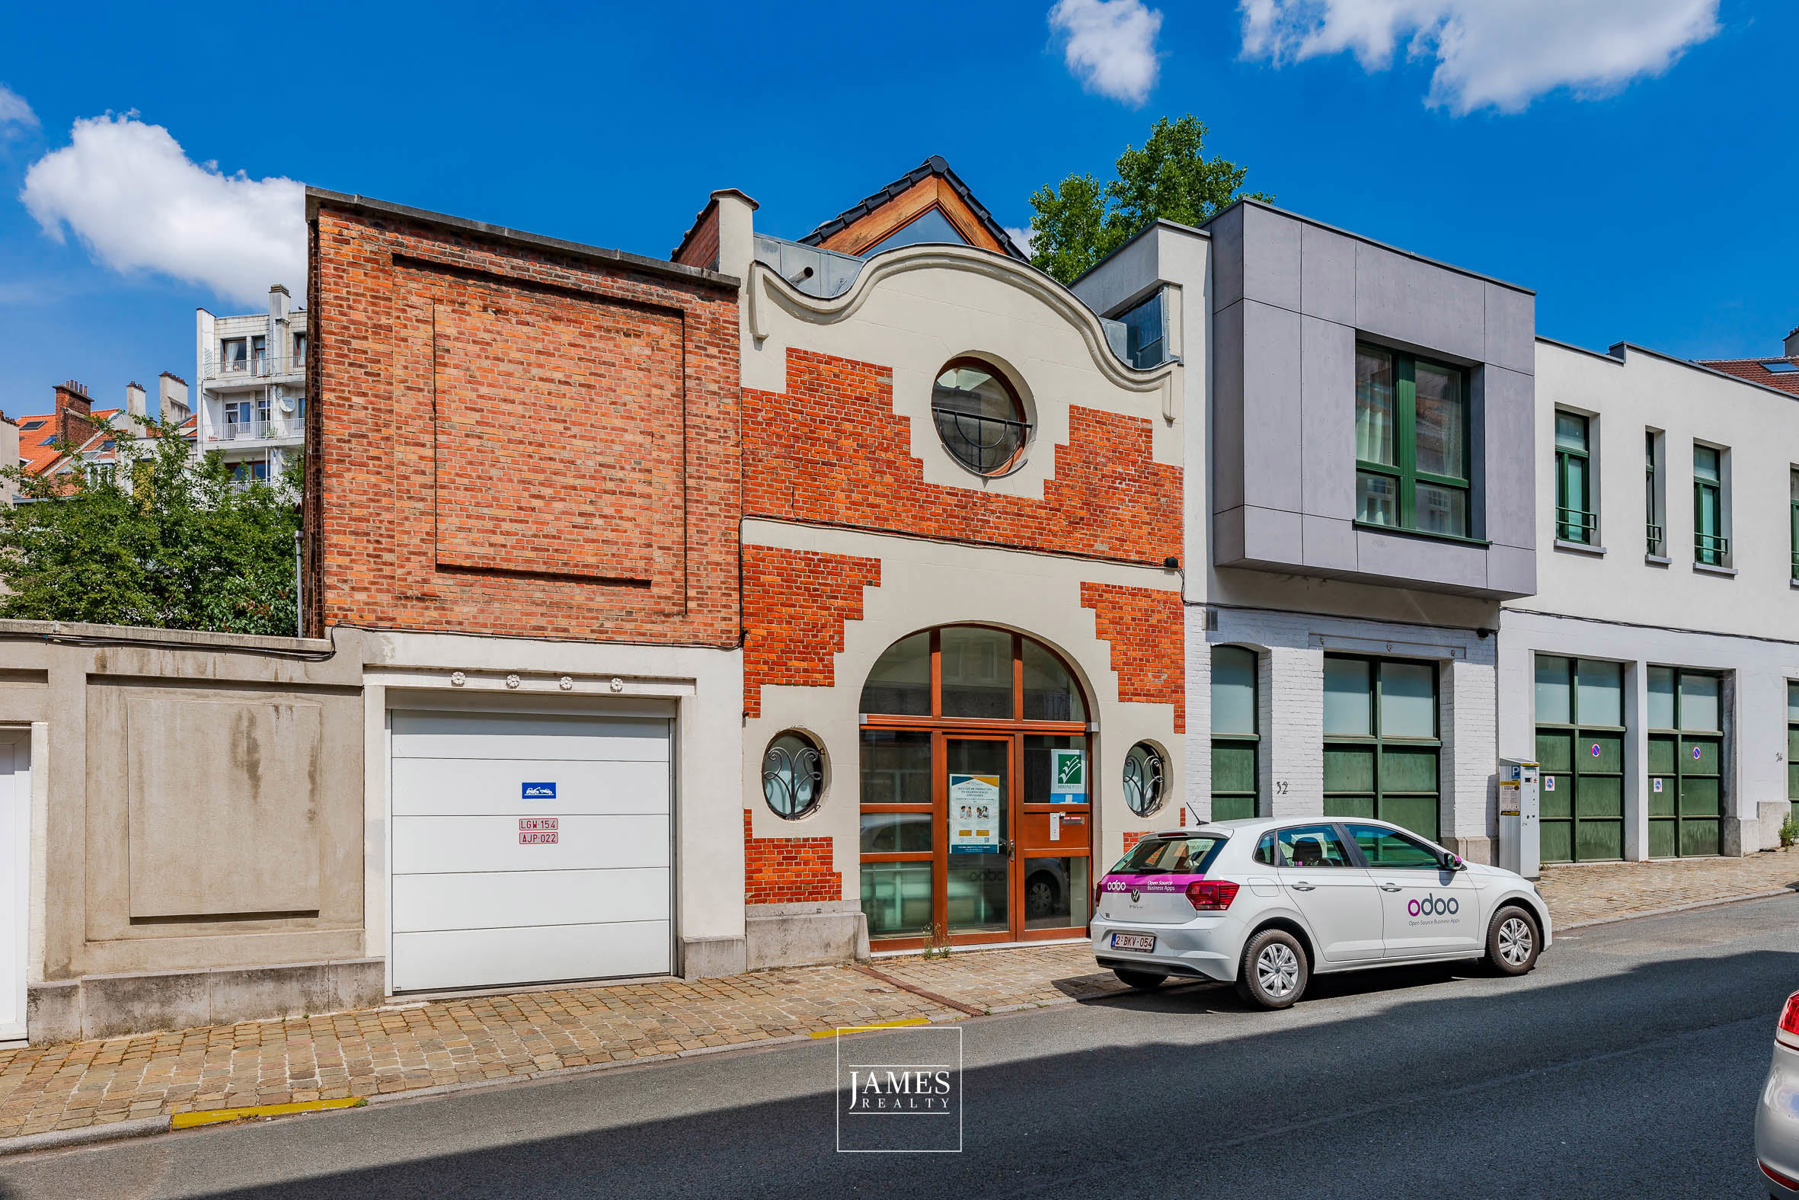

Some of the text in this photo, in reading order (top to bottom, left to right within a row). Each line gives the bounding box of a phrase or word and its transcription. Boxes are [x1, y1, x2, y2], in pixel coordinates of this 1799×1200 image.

[1512, 767, 1519, 776] P
[1107, 880, 1126, 891] odoo
[1408, 892, 1459, 917] odoo
